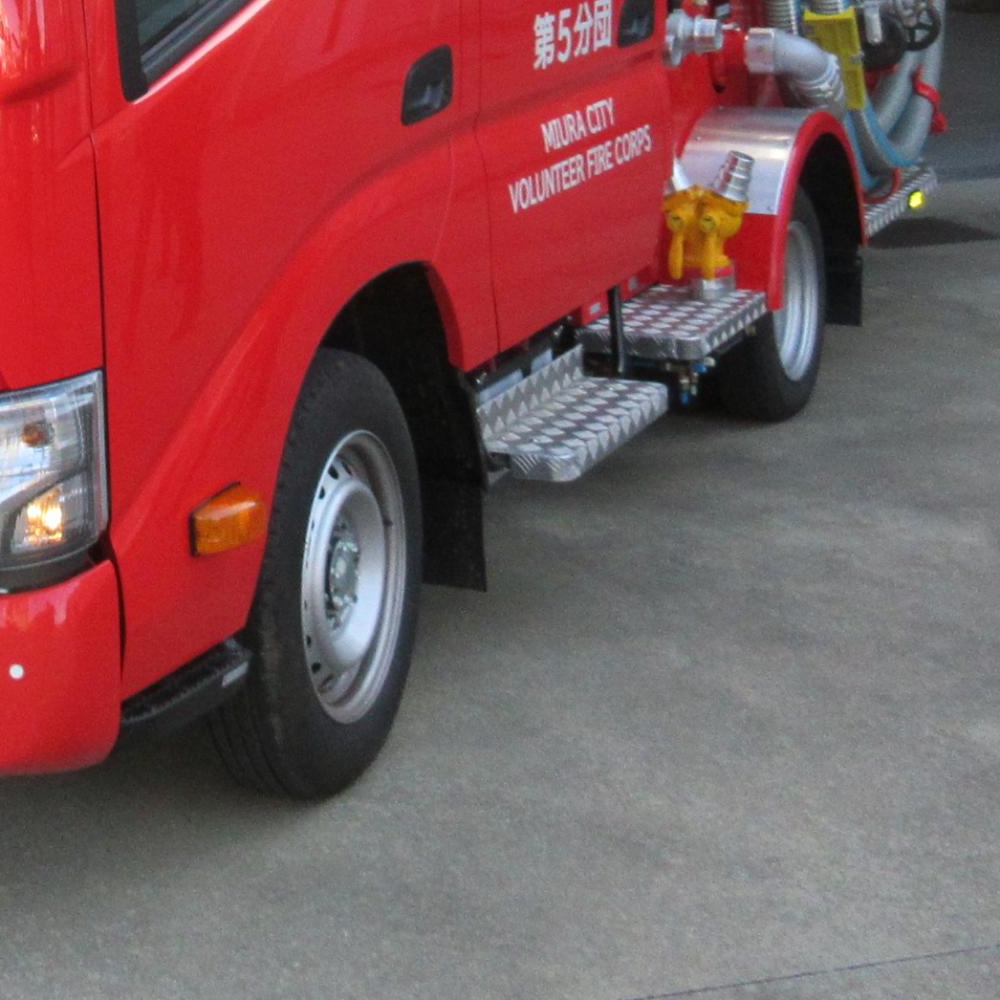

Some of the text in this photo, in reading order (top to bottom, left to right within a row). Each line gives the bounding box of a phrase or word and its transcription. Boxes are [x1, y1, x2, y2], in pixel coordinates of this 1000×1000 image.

[540, 97, 615, 153] MIURA CITY
[508, 124, 652, 214] VOLUNTEER FIRE CORPS
